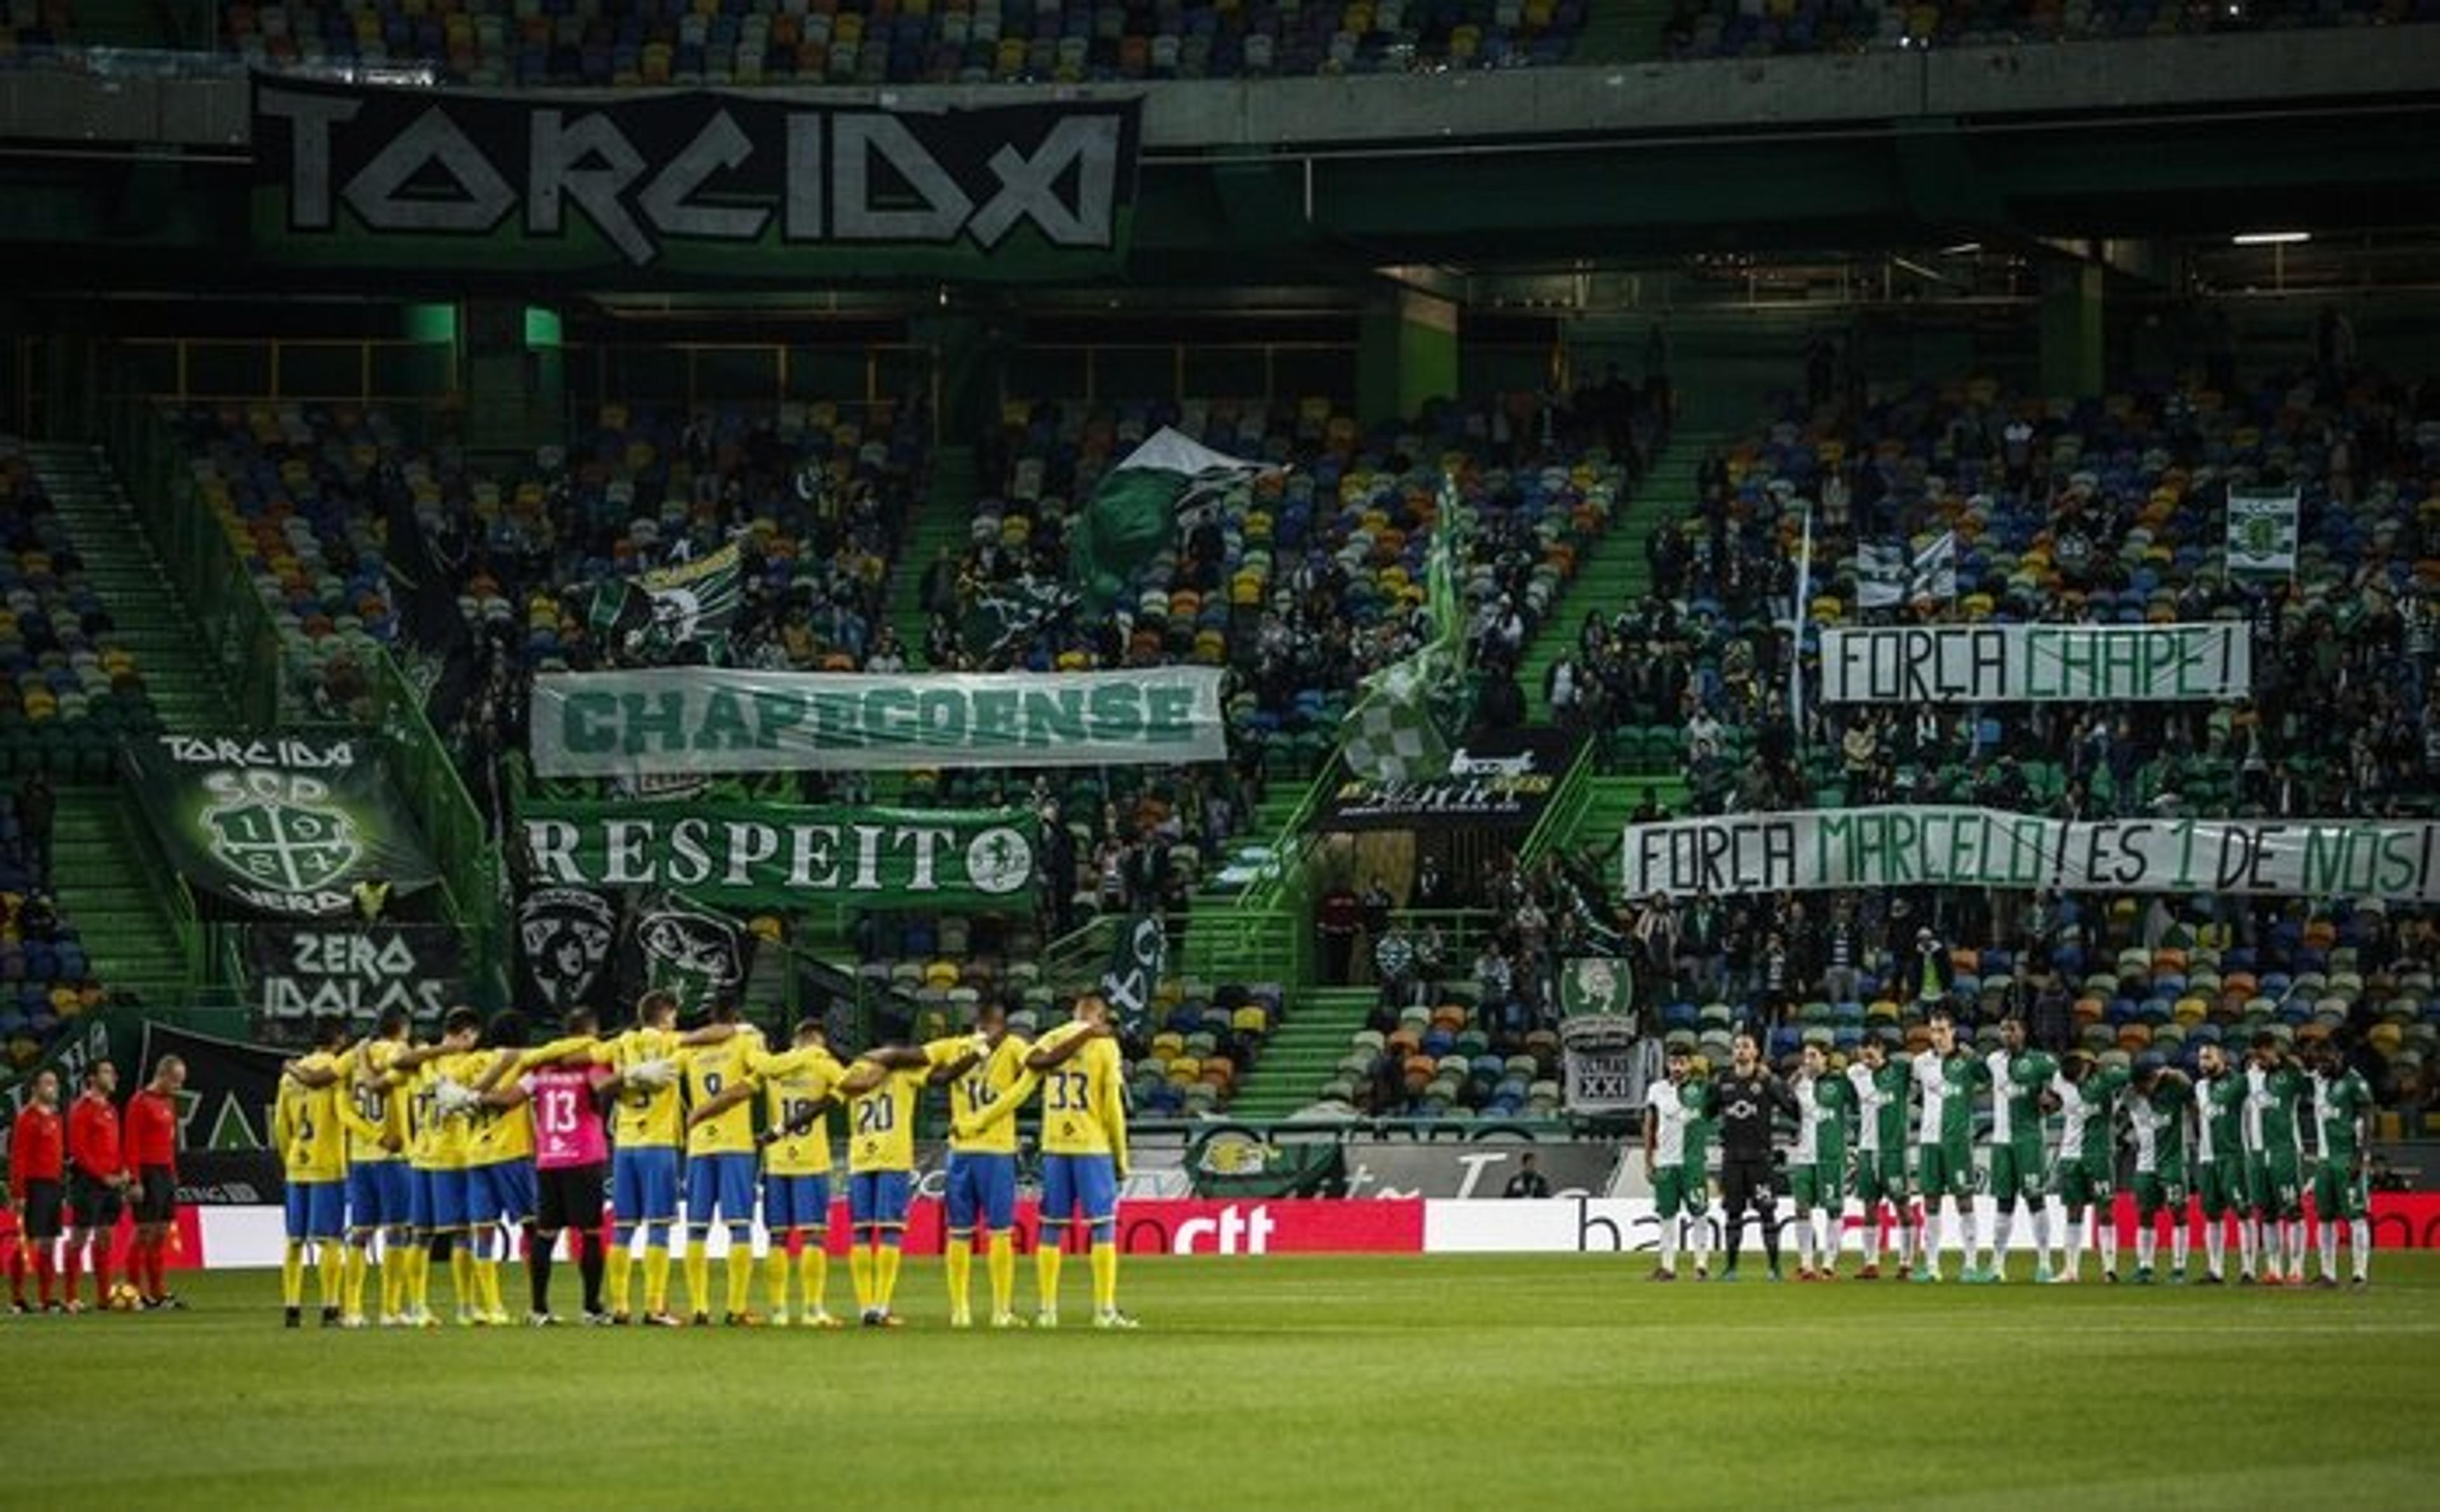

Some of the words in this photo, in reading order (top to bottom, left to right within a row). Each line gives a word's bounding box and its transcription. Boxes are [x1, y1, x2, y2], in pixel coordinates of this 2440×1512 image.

[256, 89, 1121, 266] TORCIDA
[2025, 626, 2231, 696] CHAPE!
[562, 682, 1195, 755] CHAPECOENSE
[1818, 813, 2069, 886] MARCELO!
[2169, 816, 2196, 888] 1
[2216, 825, 2288, 889] DE
[545, 1088, 576, 1133] 13
[858, 1093, 893, 1135] 20
[1047, 1071, 1090, 1110] 33
